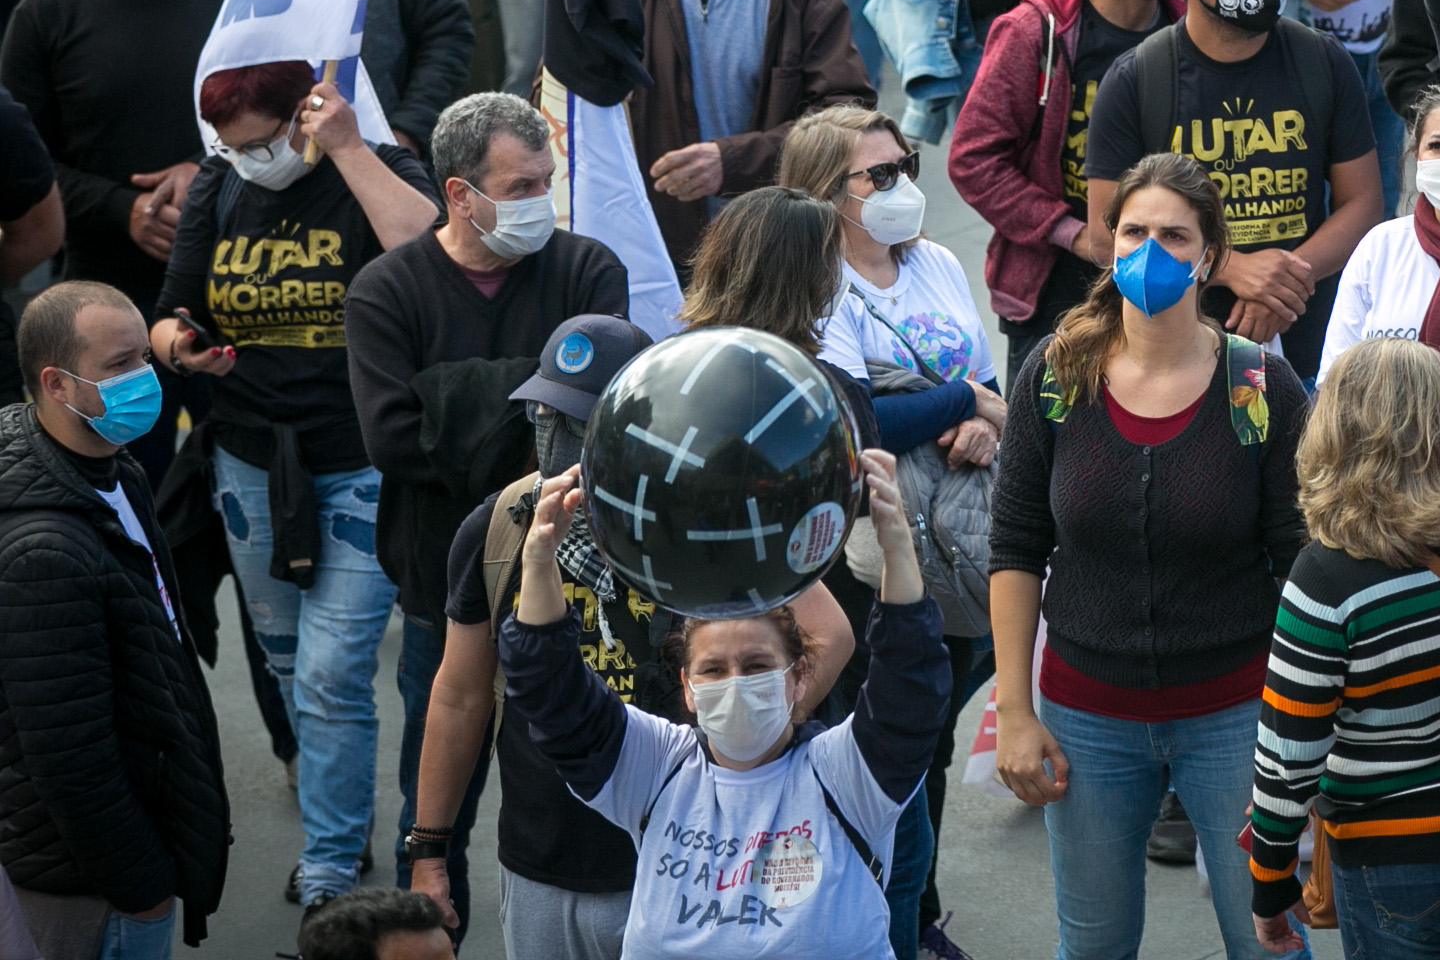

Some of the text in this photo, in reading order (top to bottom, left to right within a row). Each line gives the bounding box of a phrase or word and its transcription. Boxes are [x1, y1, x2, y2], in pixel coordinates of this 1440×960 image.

[1171, 110, 1308, 162] LUTAR
[1213, 158, 1235, 171] OU
[1208, 167, 1308, 199] ORRER
[1224, 196, 1306, 218] ALHANDO
[212, 228, 344, 278] LUTAR
[243, 272, 268, 284] OU
[208, 279, 346, 312] MORRER
[665, 820, 740, 857] NOSSOS
[656, 851, 754, 891] SÓ A LUT
[761, 876, 771, 884] DO
